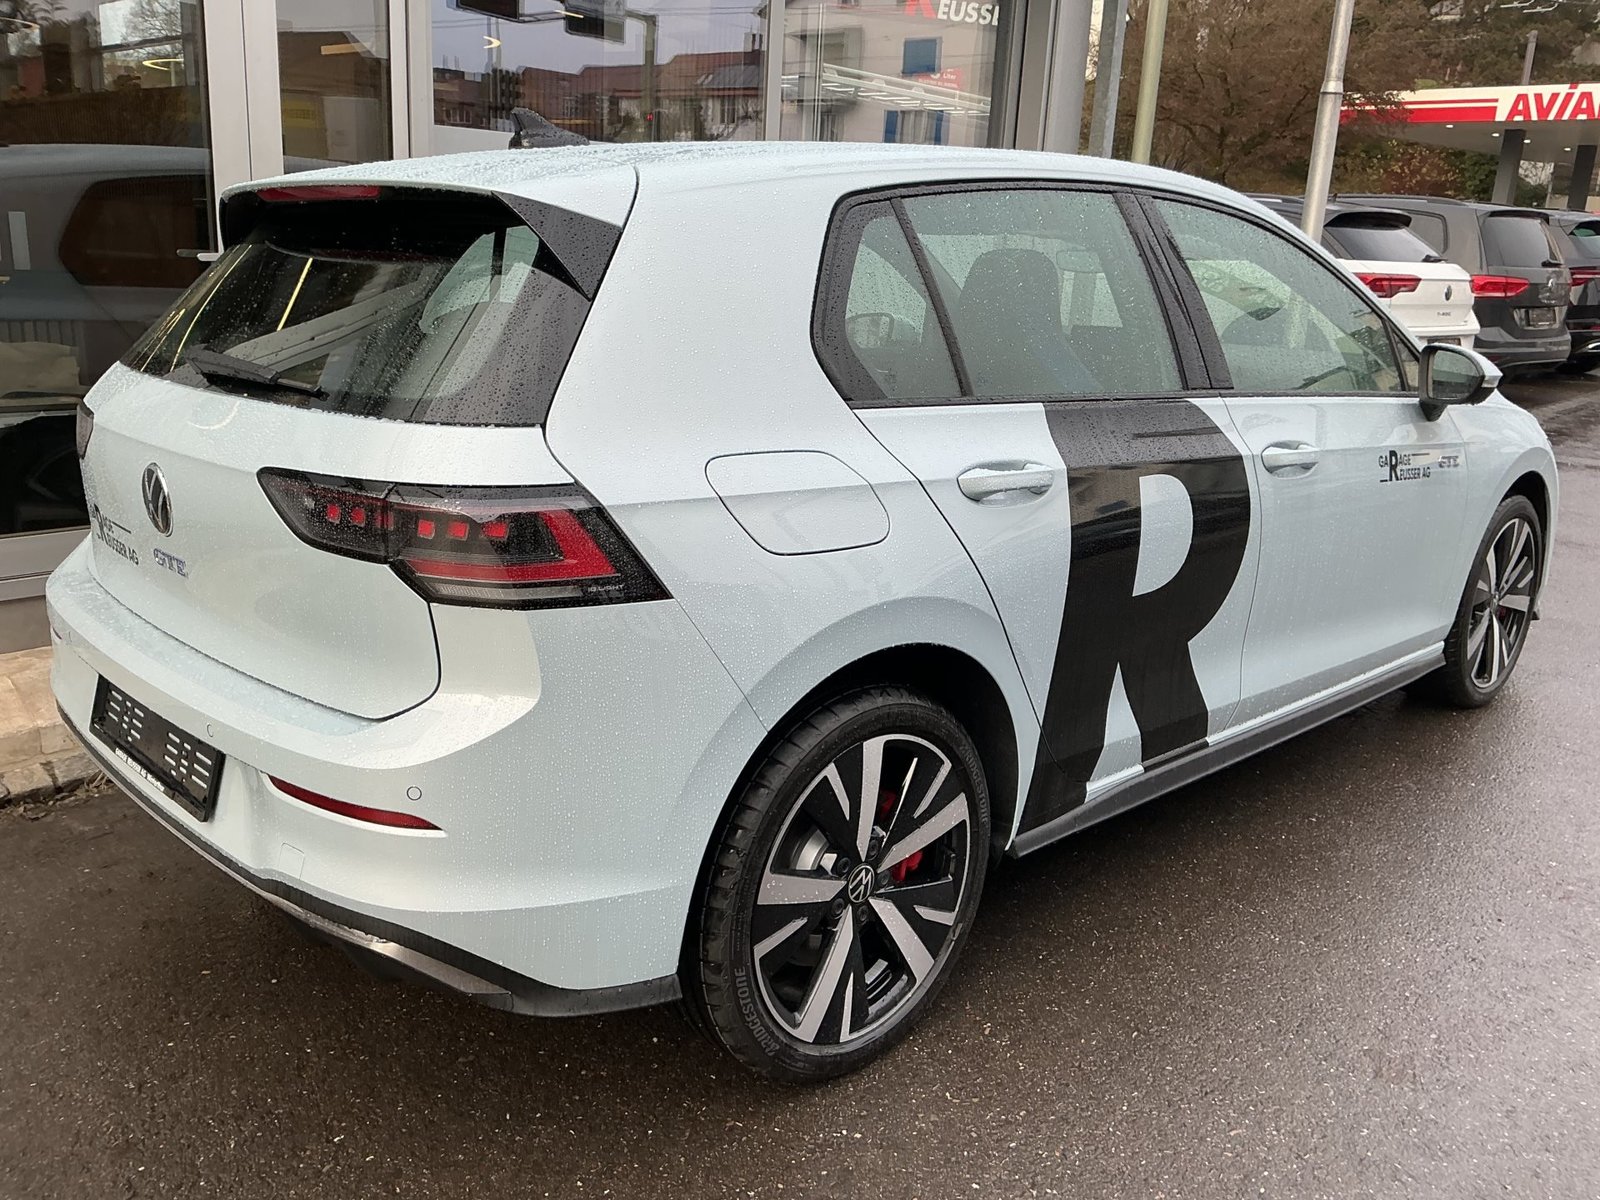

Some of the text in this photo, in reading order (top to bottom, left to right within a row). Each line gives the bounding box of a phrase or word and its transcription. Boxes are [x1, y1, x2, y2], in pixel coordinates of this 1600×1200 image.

[1422, 466, 1431, 478] AG
[153, 548, 188, 578] GTE
[1013, 398, 1252, 839] R
[734, 966, 781, 1057] BRIDGESTONE
